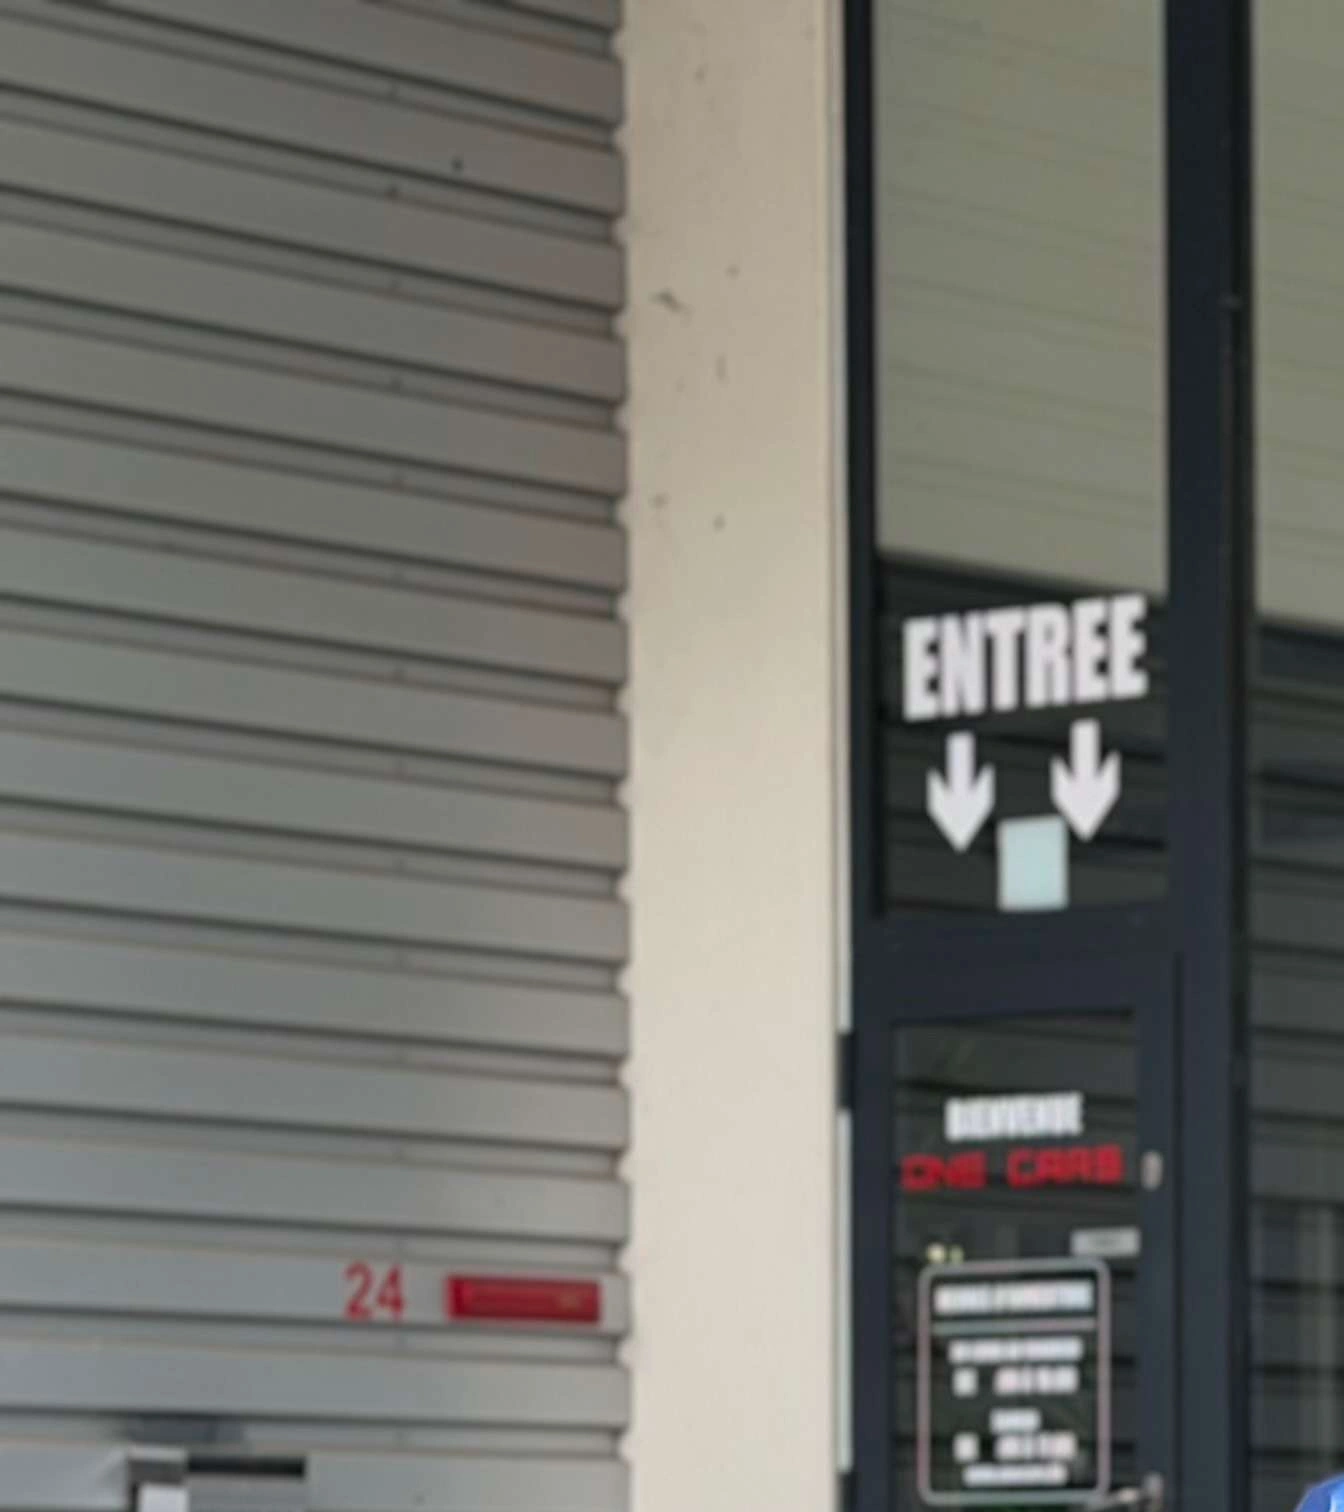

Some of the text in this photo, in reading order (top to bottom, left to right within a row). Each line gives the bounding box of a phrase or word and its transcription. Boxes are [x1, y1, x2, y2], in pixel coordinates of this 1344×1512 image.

[901, 594, 1149, 722] ENTREE
[1006, 1143, 1125, 1189] CARS
[343, 1259, 404, 1321] 24
